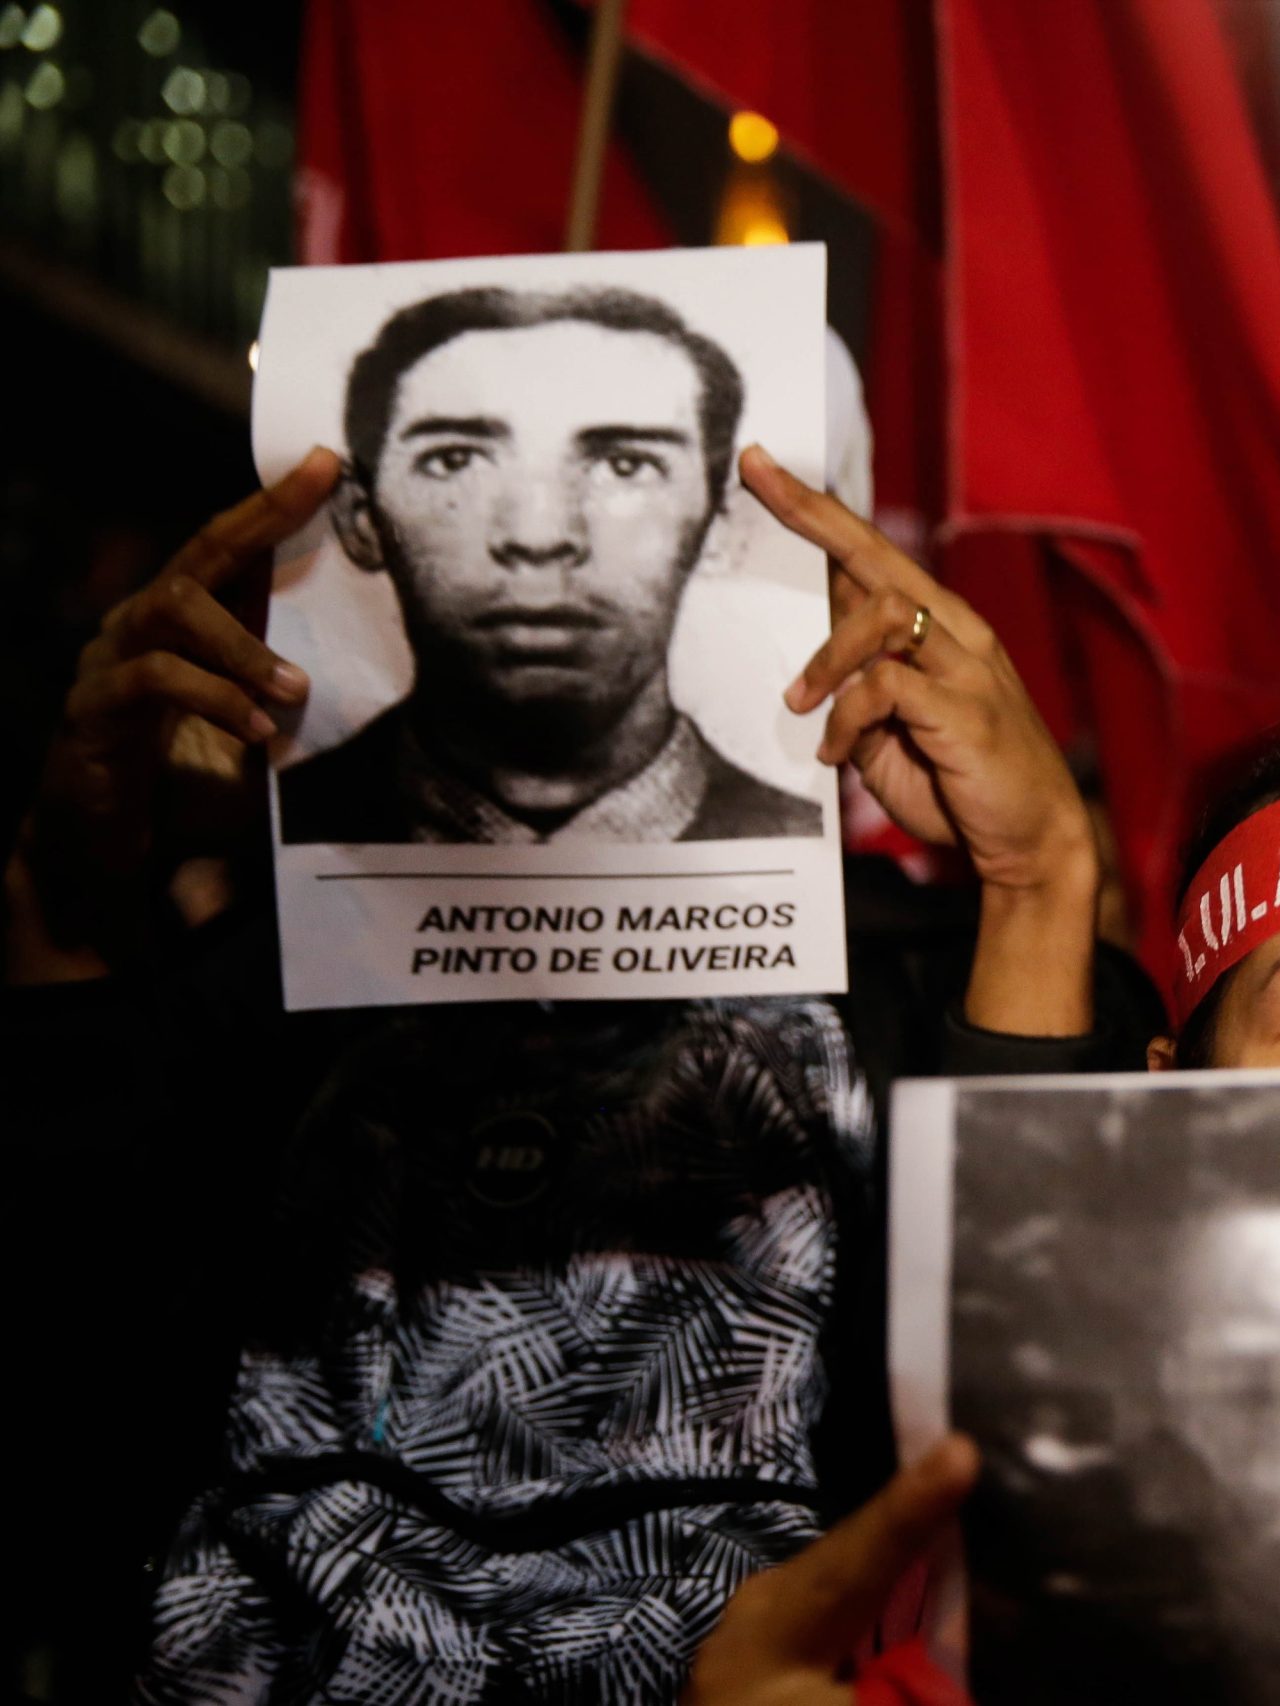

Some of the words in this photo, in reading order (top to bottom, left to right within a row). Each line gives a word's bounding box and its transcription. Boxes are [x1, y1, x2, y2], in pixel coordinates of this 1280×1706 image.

[417, 905, 605, 933] ANTONIO
[616, 902, 796, 932] MARCOS
[410, 946, 538, 975] PINTO
[549, 946, 602, 974] DE
[612, 944, 797, 974] OLIVEIRA
